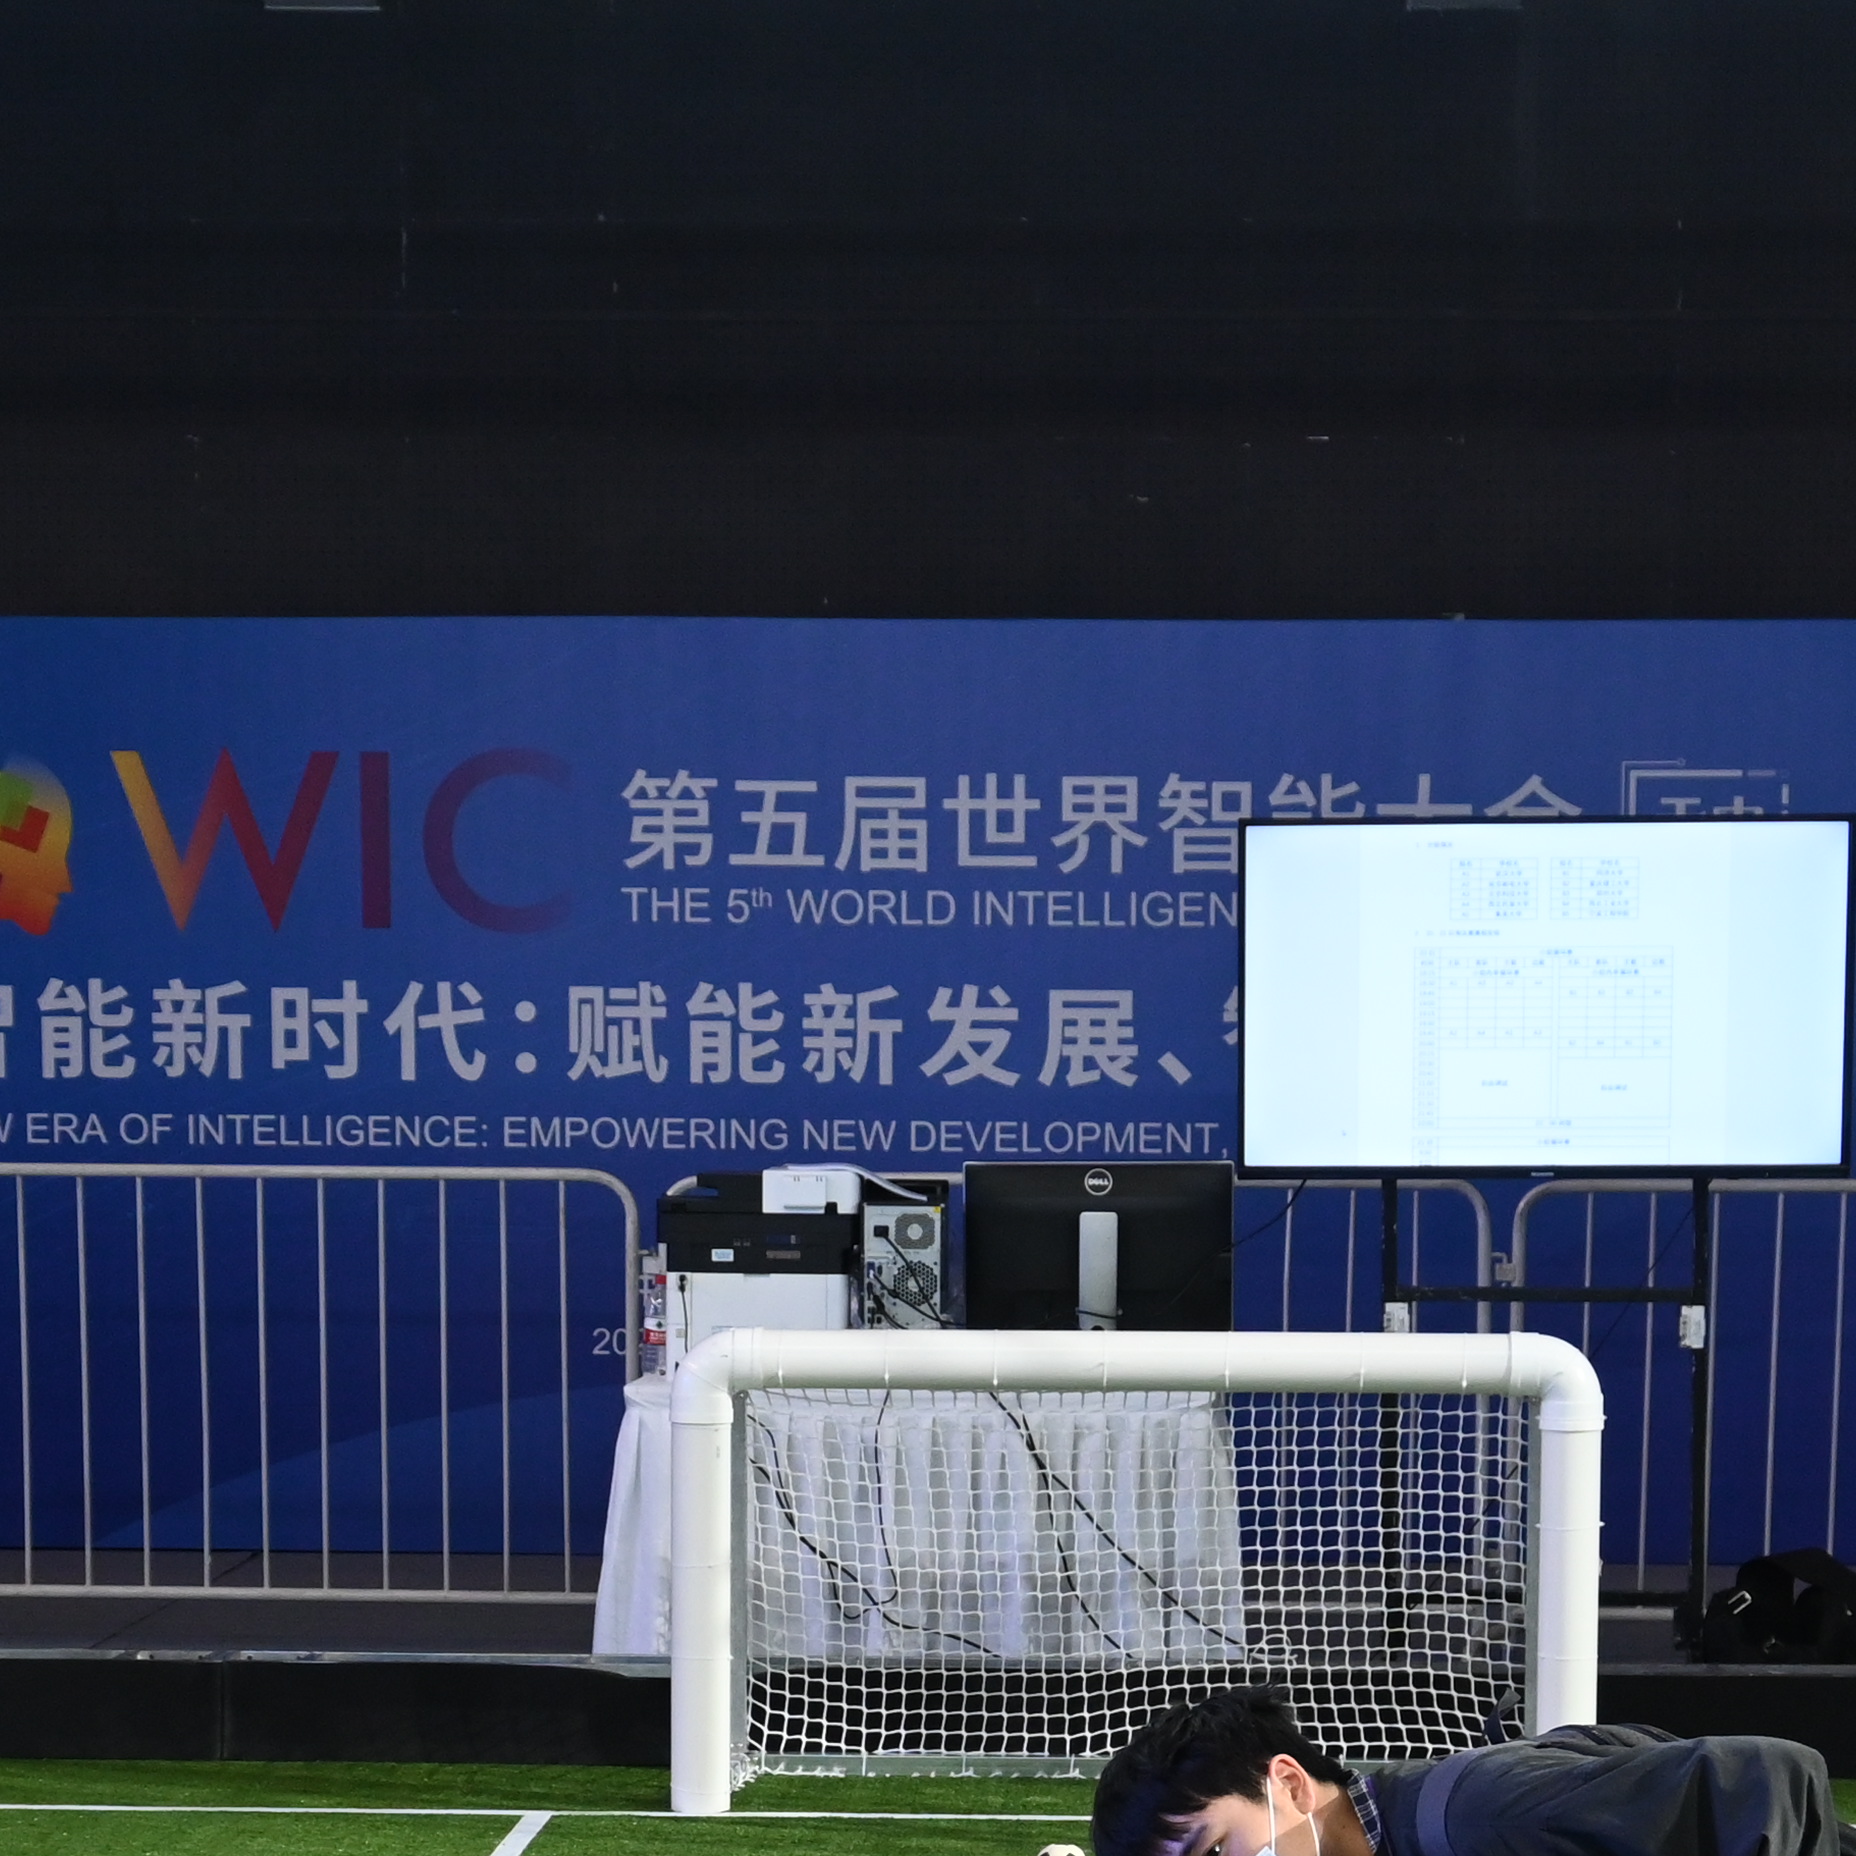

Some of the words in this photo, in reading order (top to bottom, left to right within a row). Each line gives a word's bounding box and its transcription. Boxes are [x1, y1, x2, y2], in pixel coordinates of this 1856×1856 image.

[110, 746, 575, 934] WIC
[621, 887, 712, 924] THE
[727, 887, 774, 925] 5th
[787, 889, 957, 927] WORLD
[973, 890, 1238, 928] INTELLIGEN
[27, 1113, 107, 1145] ERA
[119, 1114, 173, 1145] OF
[189, 1115, 488, 1148] INTELLIGENCE:
[504, 1117, 789, 1151] EMPOWERING
[804, 1119, 897, 1152] NEW
[911, 1121, 1229, 1159] DEVELOPMENT,
[1088, 1177, 1110, 1186] DELL
